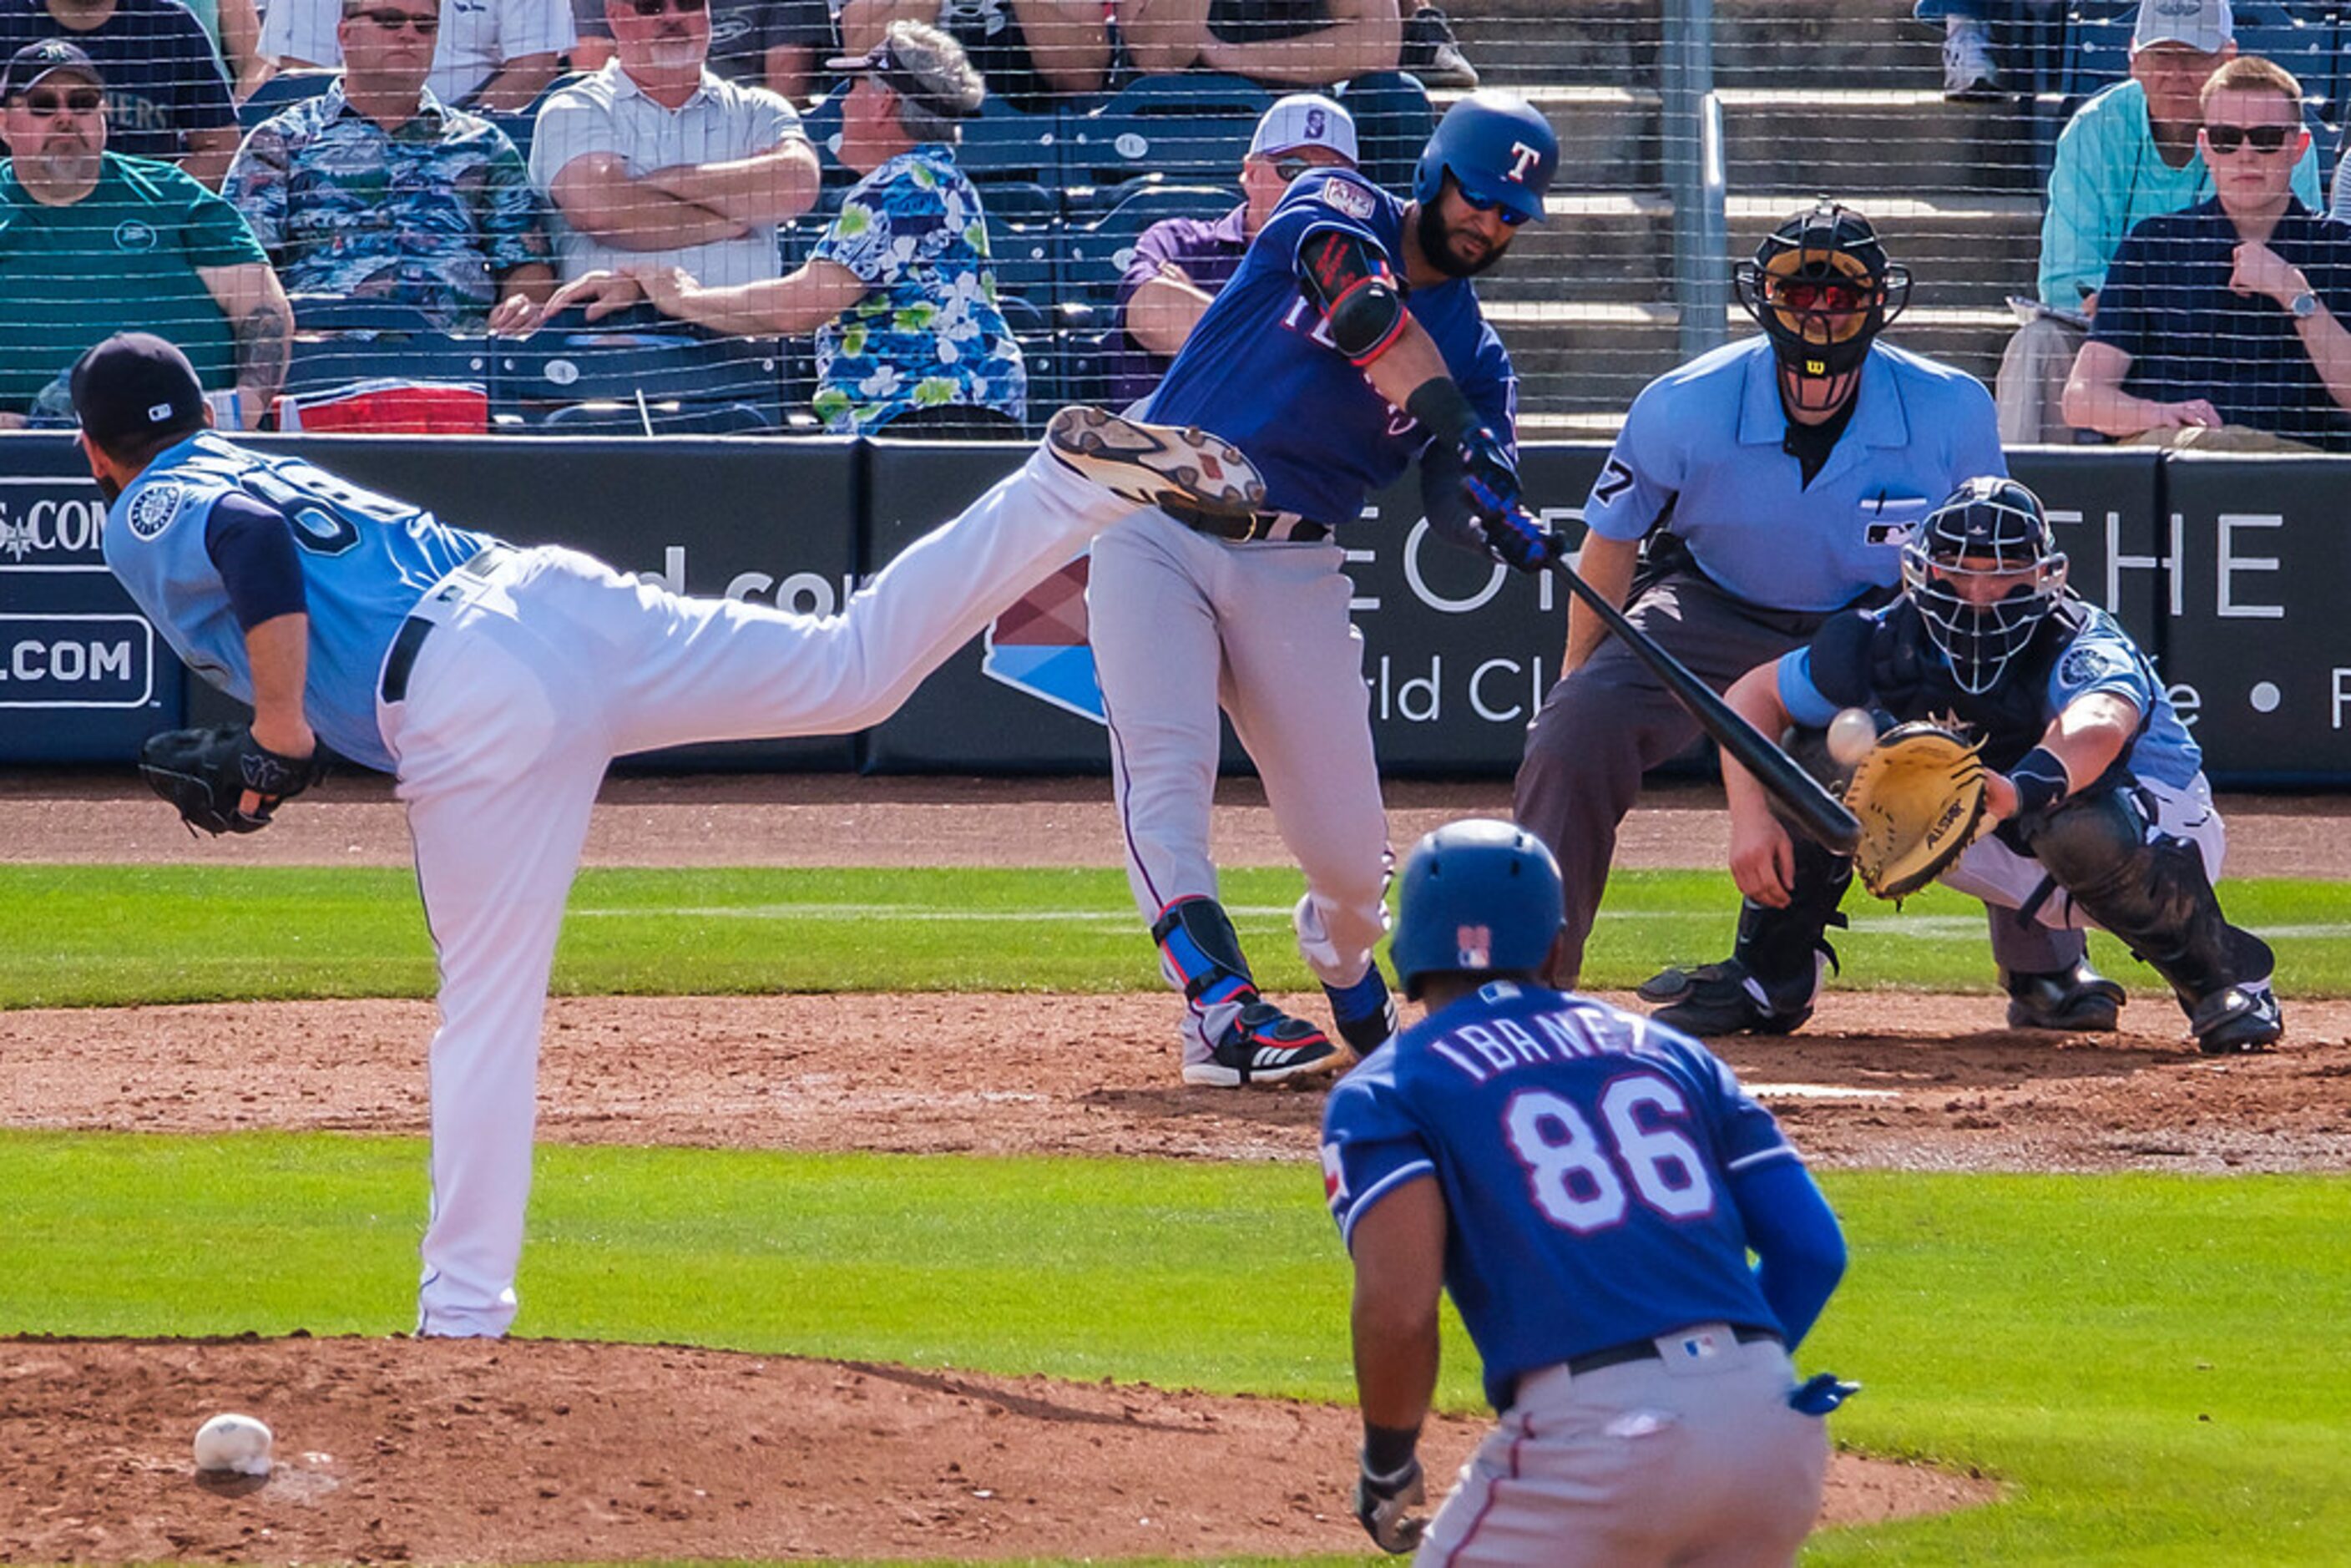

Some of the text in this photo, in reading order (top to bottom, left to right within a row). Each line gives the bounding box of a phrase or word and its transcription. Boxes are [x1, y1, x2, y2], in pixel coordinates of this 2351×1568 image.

[1304, 109, 1326, 139] S
[1510, 140, 1541, 184] T
[1368, 655, 1441, 721] ld
[1502, 1072, 1715, 1234] 86
